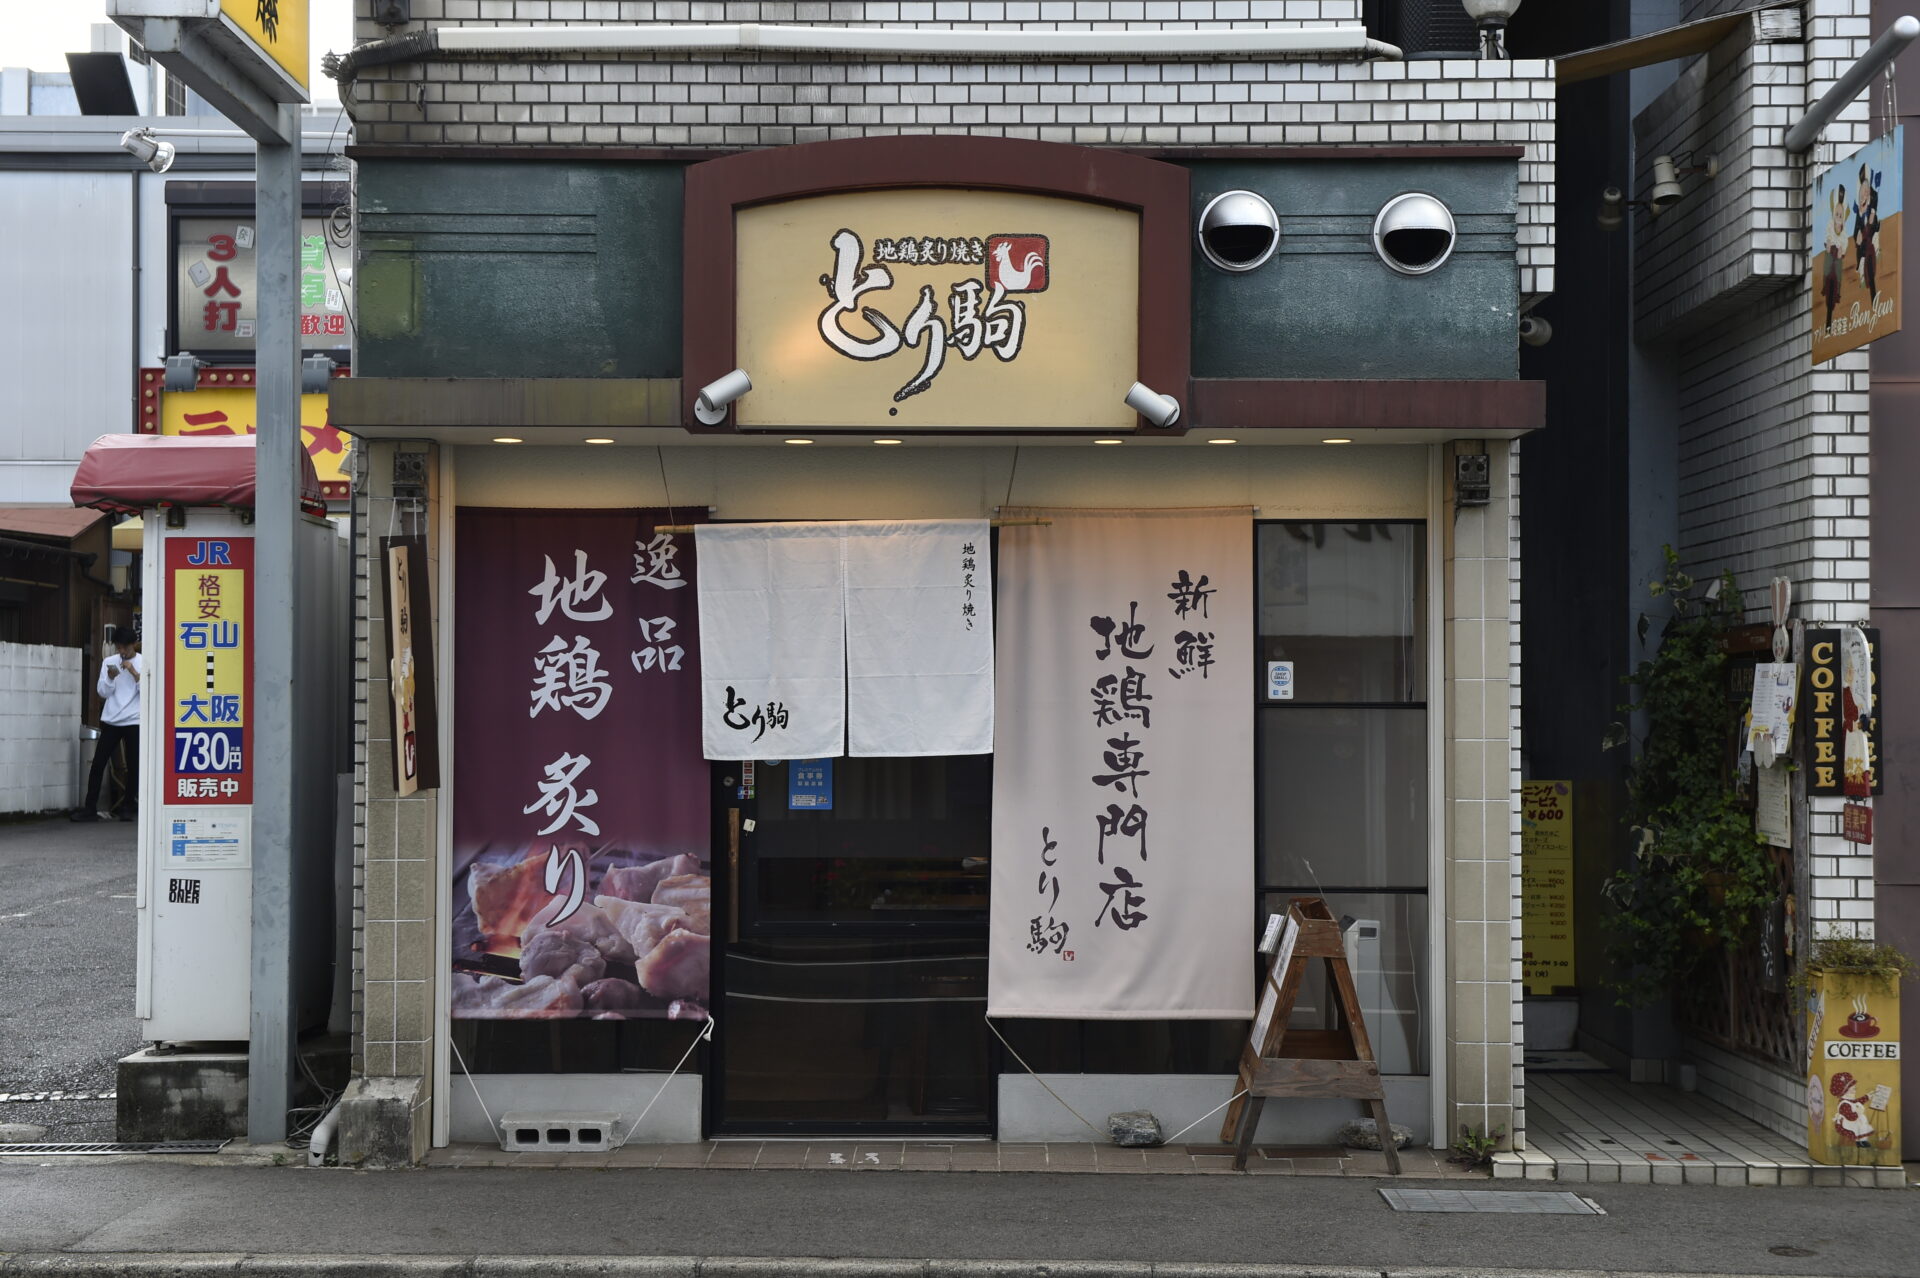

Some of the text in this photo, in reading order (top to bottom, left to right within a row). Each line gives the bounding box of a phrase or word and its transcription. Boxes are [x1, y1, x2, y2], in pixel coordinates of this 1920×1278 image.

[873, 236, 986, 265] 地鶏炙り焼き
[203, 234, 242, 332] 3人打
[818, 228, 1026, 413] とり駒
[187, 541, 232, 566] JR
[198, 574, 221, 619] 格安
[630, 534, 688, 674] 逸品
[962, 541, 976, 631] 地鶏炙り焼き
[179, 620, 240, 650] 石山
[1167, 570, 1217, 680] 新鮮
[179, 694, 240, 723] 大阪
[723, 686, 789, 744] とり駒
[1811, 641, 1836, 788] COFFEE
[176, 732, 242, 772] 730円
[1090, 601, 1154, 932] 地鶏専門店
[177, 778, 240, 798] 販売中
[1522, 786, 1553, 797] ニング
[1528, 809, 1564, 820] ¥600
[169, 878, 200, 891] BLUE
[169, 890, 200, 904] ONER
[1027, 826, 1070, 954] とり駒
[1827, 1043, 1897, 1058] COFFEE
